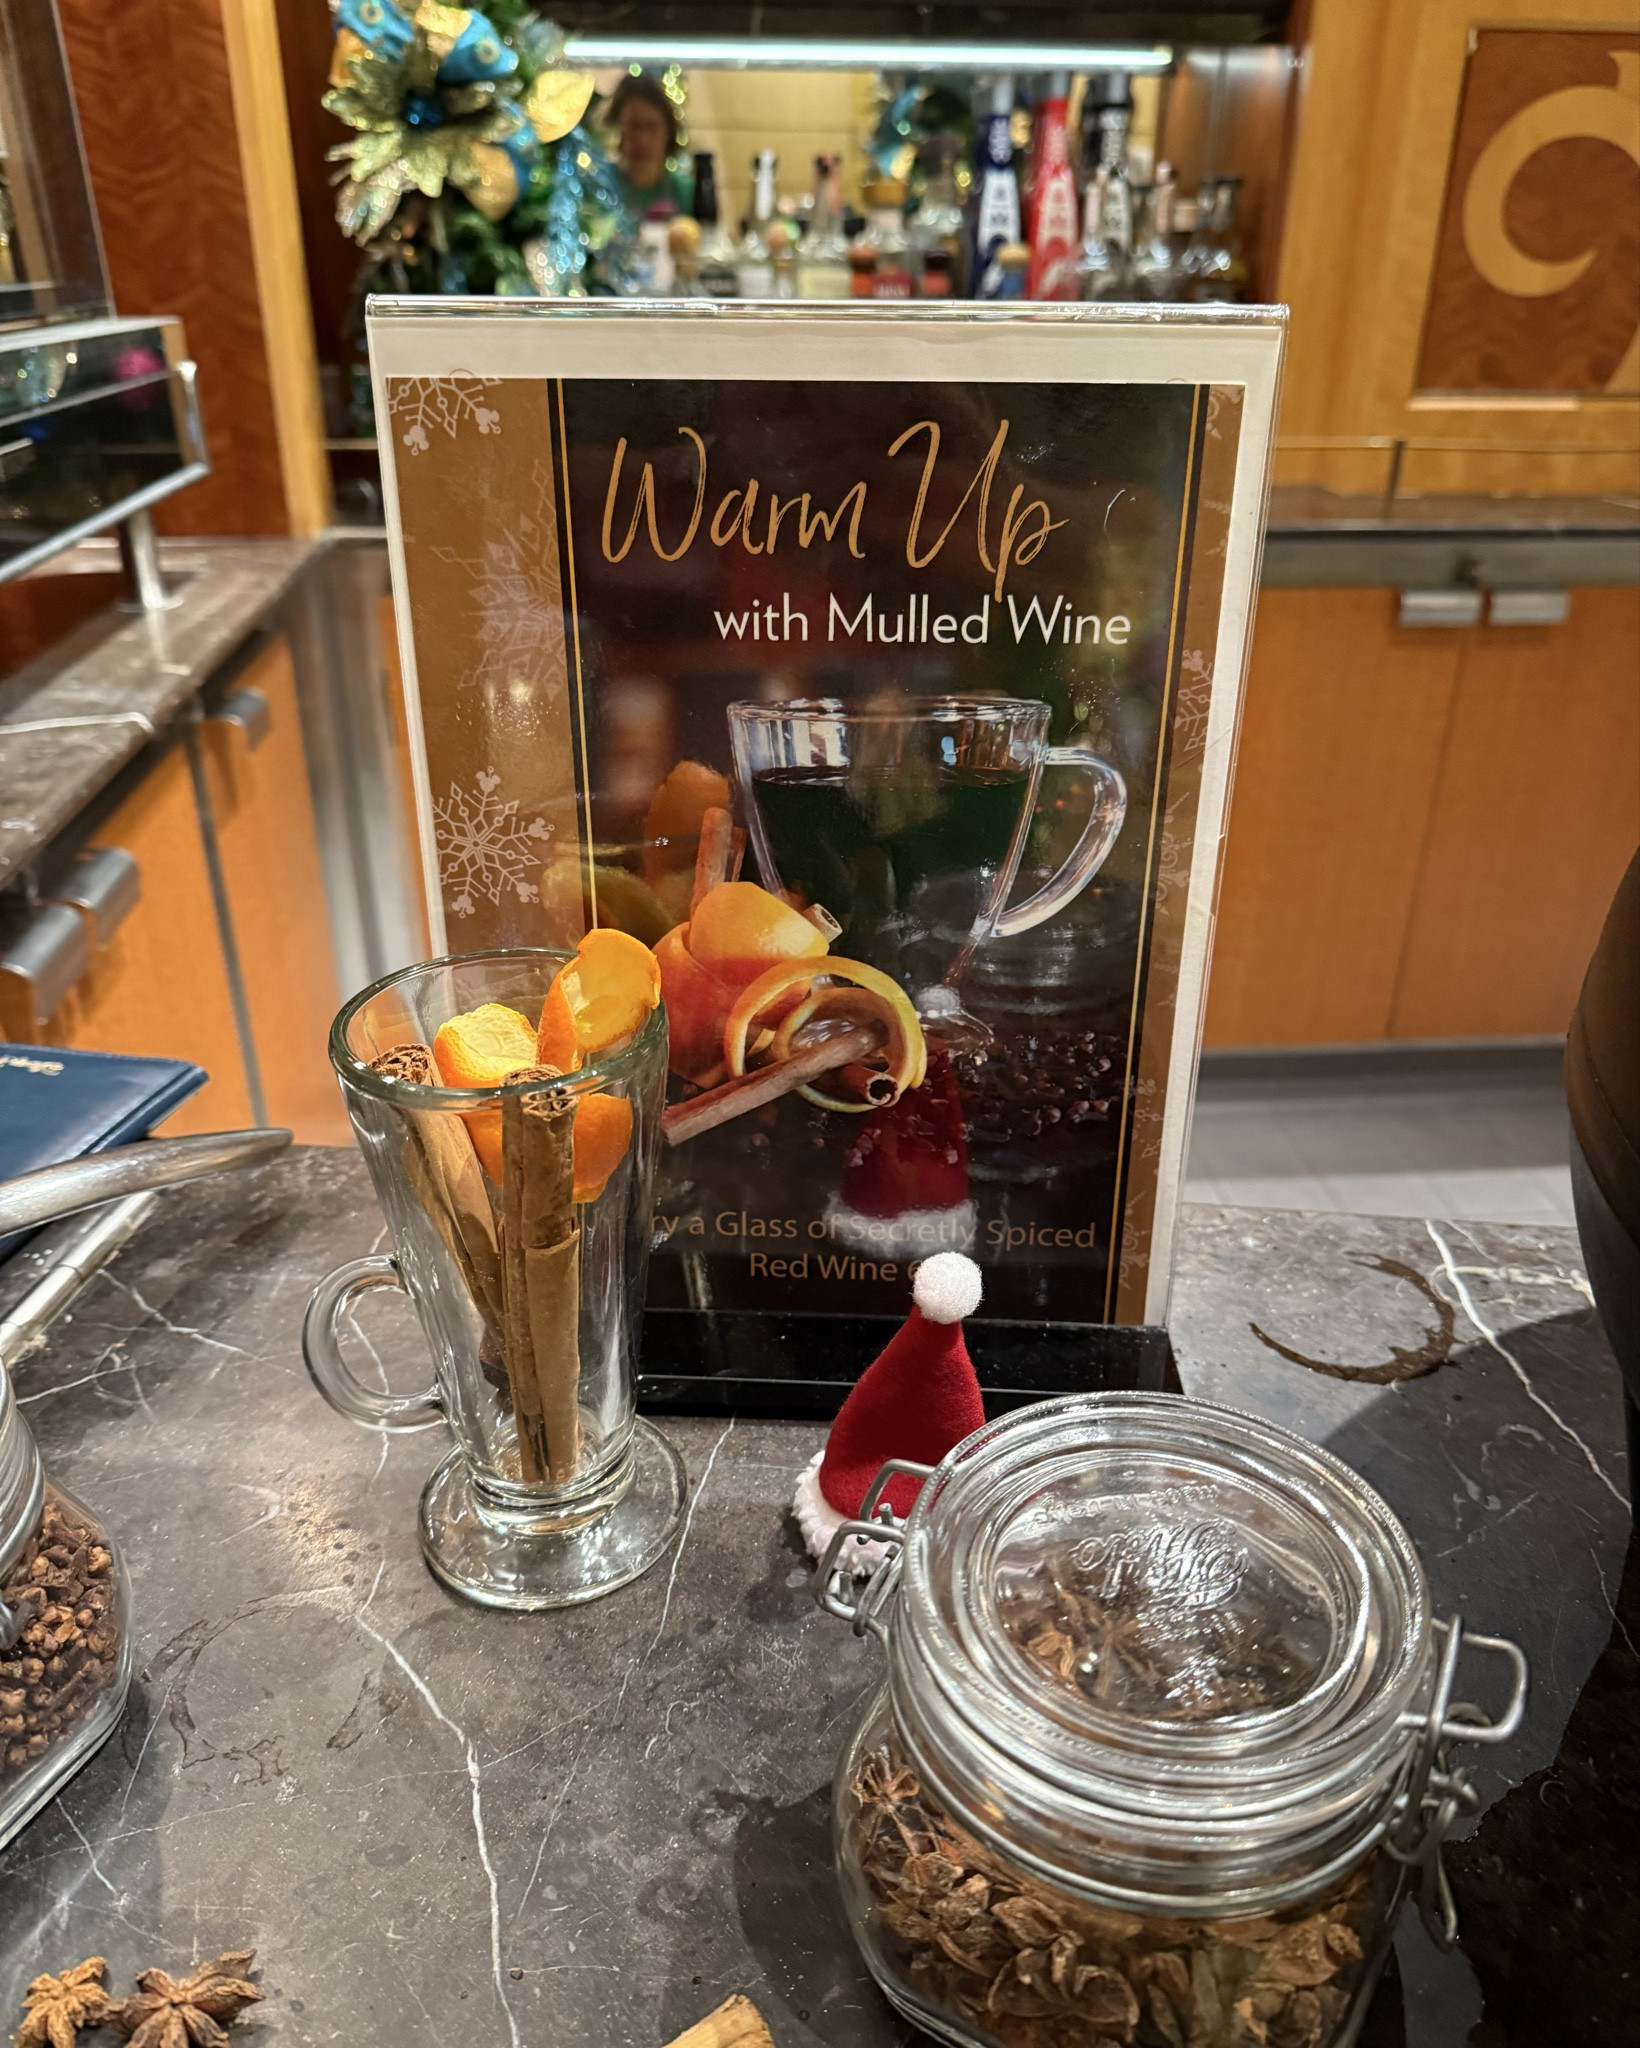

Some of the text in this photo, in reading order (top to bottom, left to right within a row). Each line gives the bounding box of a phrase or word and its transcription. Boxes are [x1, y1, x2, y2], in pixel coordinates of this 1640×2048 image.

[601, 418, 1070, 603] Warm Up
[713, 591, 1132, 645] with Mulled Wine
[649, 1210, 1096, 1251] ry a Glass of Secretly Spiced
[750, 1252, 808, 1279] Red
[818, 1254, 897, 1282] Wine
